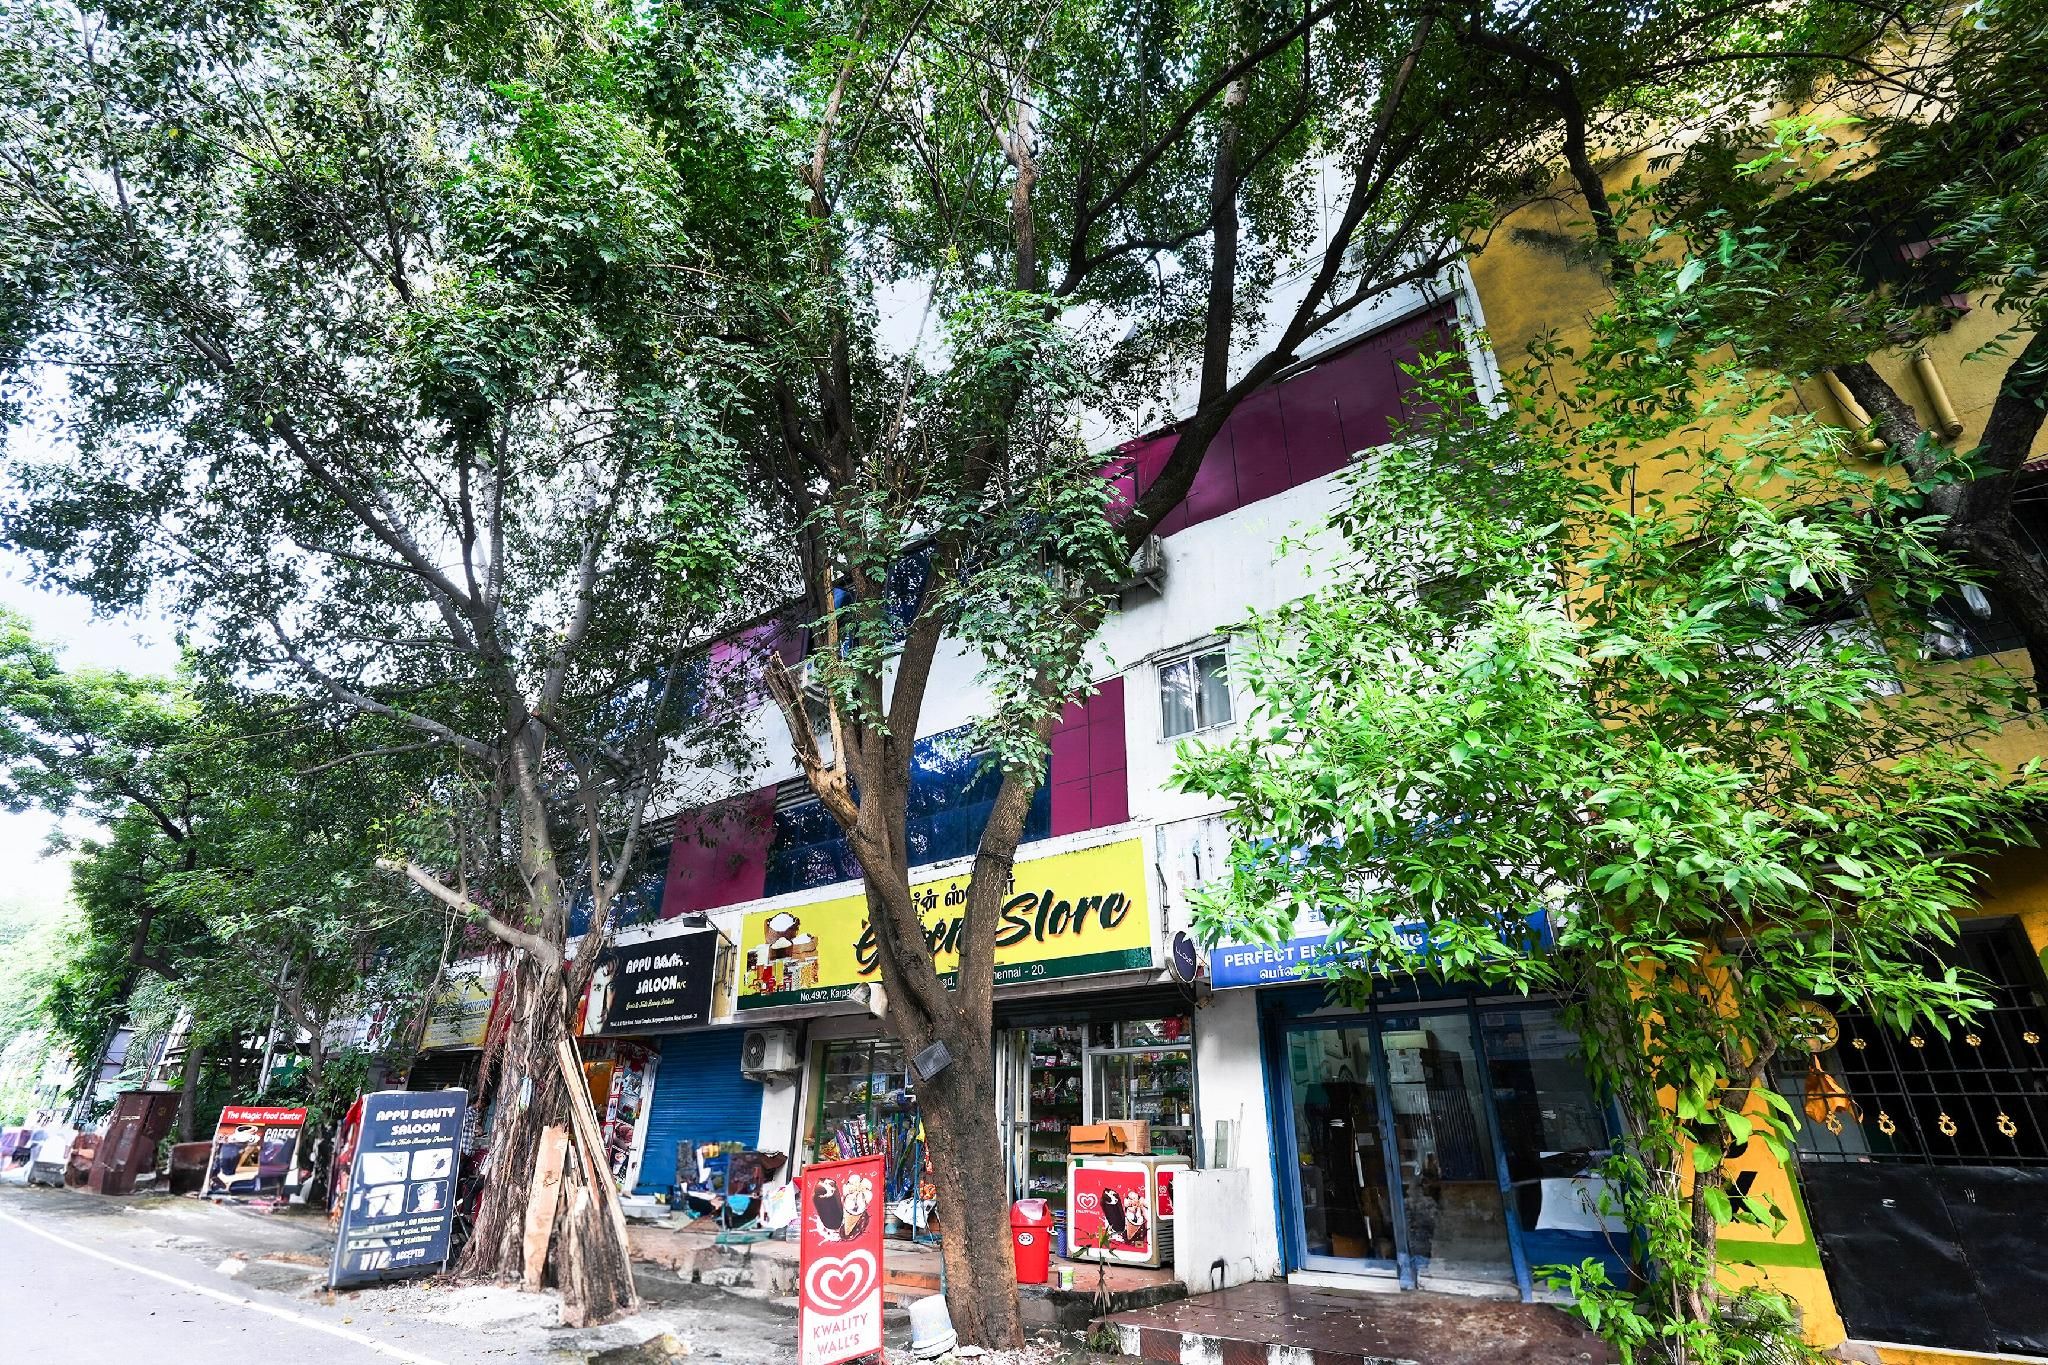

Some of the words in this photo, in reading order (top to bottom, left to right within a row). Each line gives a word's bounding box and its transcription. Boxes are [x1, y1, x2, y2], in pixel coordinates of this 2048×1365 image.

[625, 956, 652, 974] APPU
[1224, 947, 1295, 968] PERFECT
[800, 990, 829, 1002] No.49/2,
[993, 966, 1021, 980] hennai
[1031, 964, 1047, 976] 20.
[227, 1111, 239, 1120] The
[240, 1112, 262, 1122] Magic
[263, 1112, 279, 1120] Food
[279, 1112, 302, 1120] Center
[376, 1110, 409, 1121] APPU
[411, 1107, 456, 1120] BEAUTY
[391, 1122, 441, 1136] SALOON
[813, 1312, 868, 1340] KWALITY
[817, 1333, 860, 1356] WALL'S
